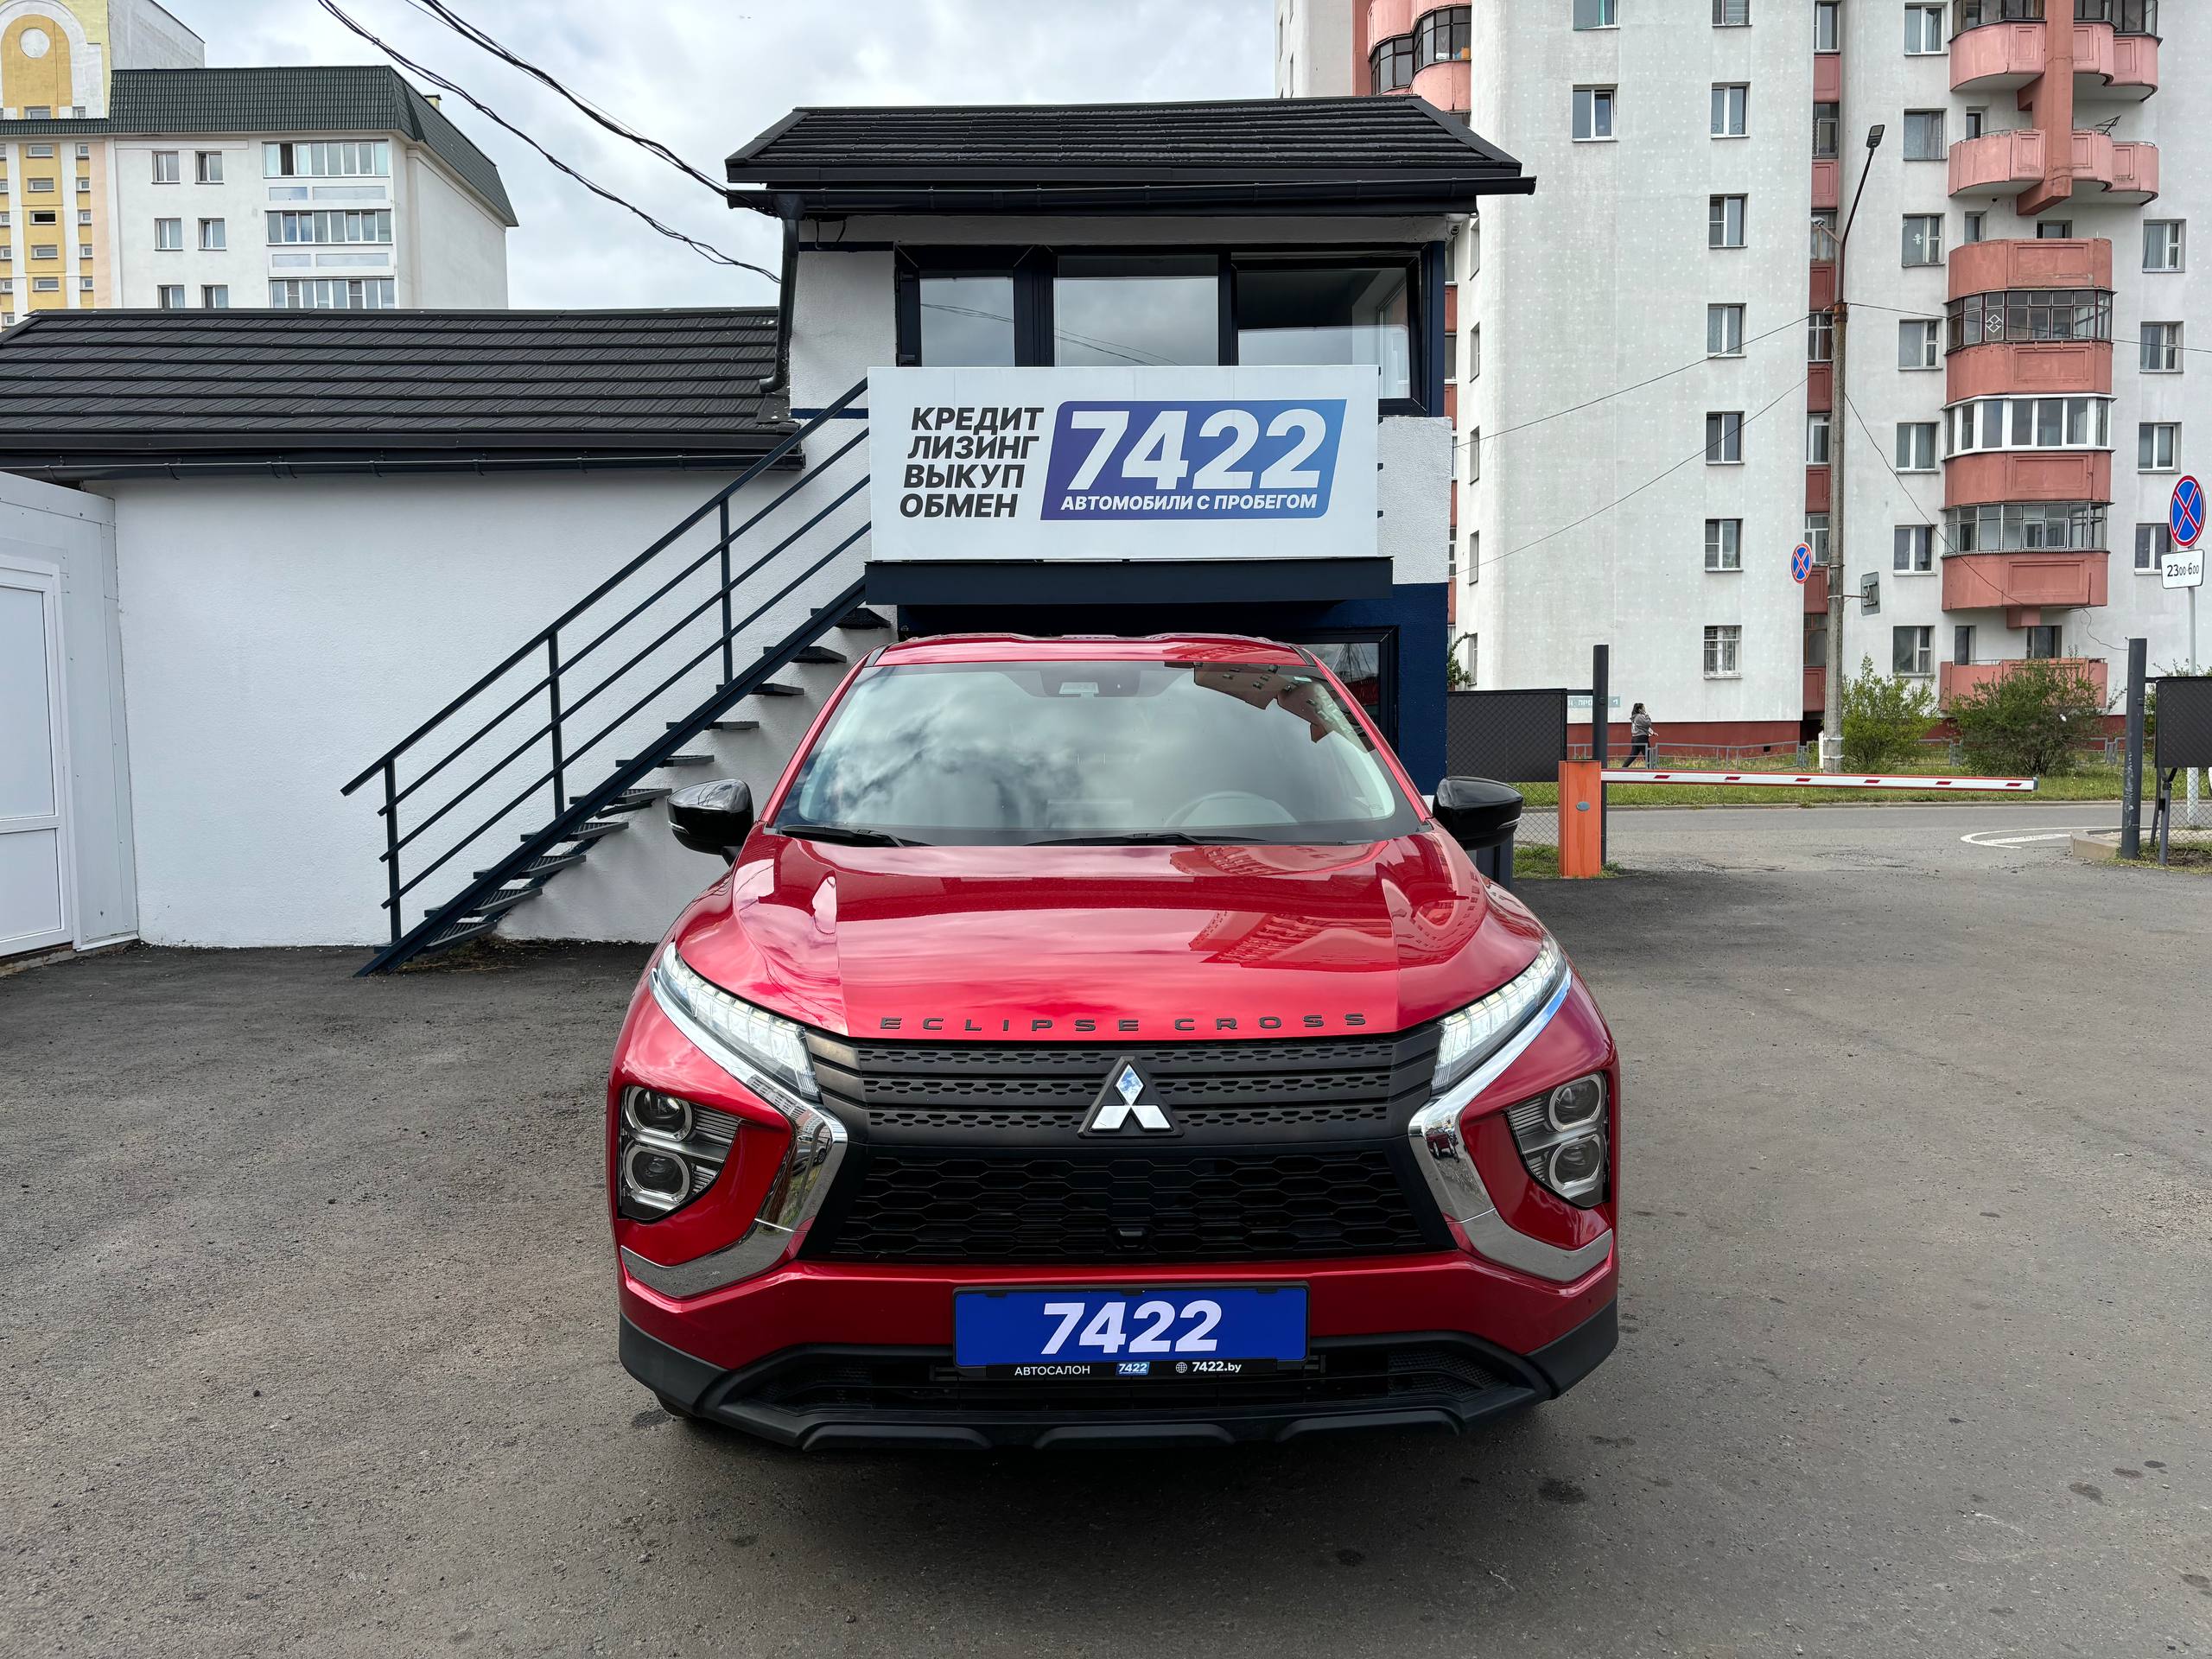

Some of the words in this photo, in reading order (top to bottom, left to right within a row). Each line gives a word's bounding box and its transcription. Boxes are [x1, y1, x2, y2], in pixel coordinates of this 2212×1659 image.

[911, 407, 1045, 435] КРЕДИТ
[907, 435, 1039, 459] ЛИЗИНГ
[1067, 409, 1327, 490] 7422
[903, 464, 1025, 488] ВЫКУП
[899, 493, 1018, 518] ОБМЕН
[1060, 495, 1193, 511] АВТОМОБИЛИ
[1197, 495, 1211, 510] С
[1213, 493, 1318, 510] ПРОБЕГОМ
[880, 1017, 1139, 1032] ECLIPSE
[1174, 1013, 1368, 1032] CROSS
[1041, 1300, 1223, 1355] 7422
[1014, 1365, 1090, 1376] АВТОСАЛОН
[1118, 1363, 1147, 1372] 7422
[1192, 1360, 1243, 1373] 7422.by
